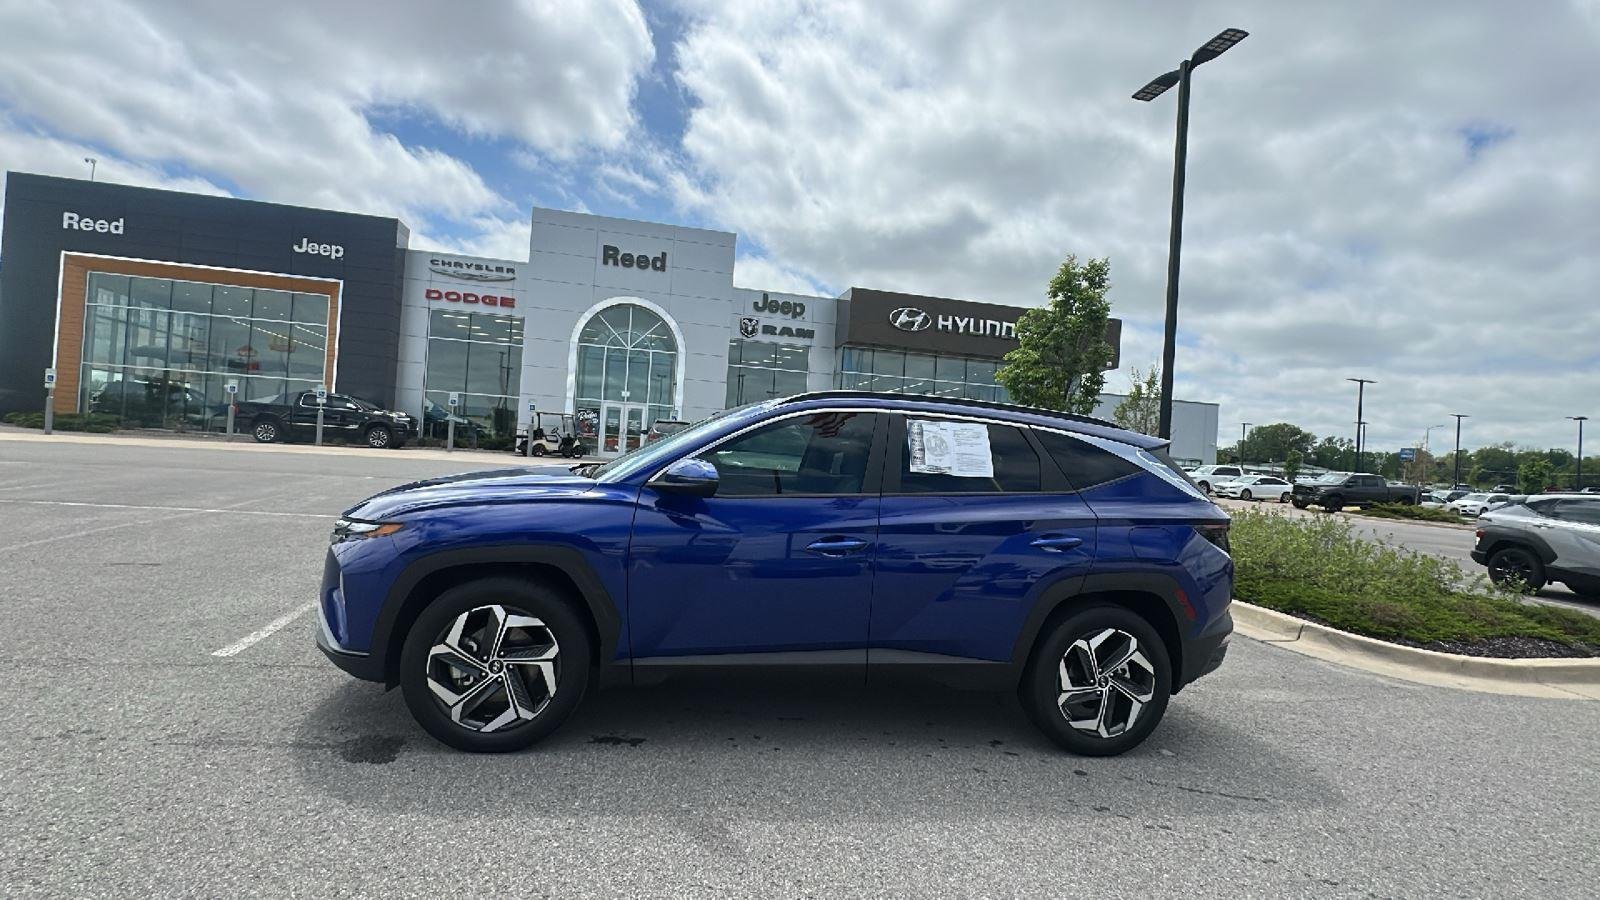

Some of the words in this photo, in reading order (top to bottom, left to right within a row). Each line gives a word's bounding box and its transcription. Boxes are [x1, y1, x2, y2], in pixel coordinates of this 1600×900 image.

[62, 211, 125, 235] Reed
[292, 237, 344, 260] Jeep
[602, 244, 667, 273] Reed
[429, 258, 516, 275] CHRYSLER
[425, 288, 515, 308] DODGE
[753, 292, 806, 320] Jeep
[761, 324, 816, 339] RAM
[937, 314, 1022, 340] HYUND
